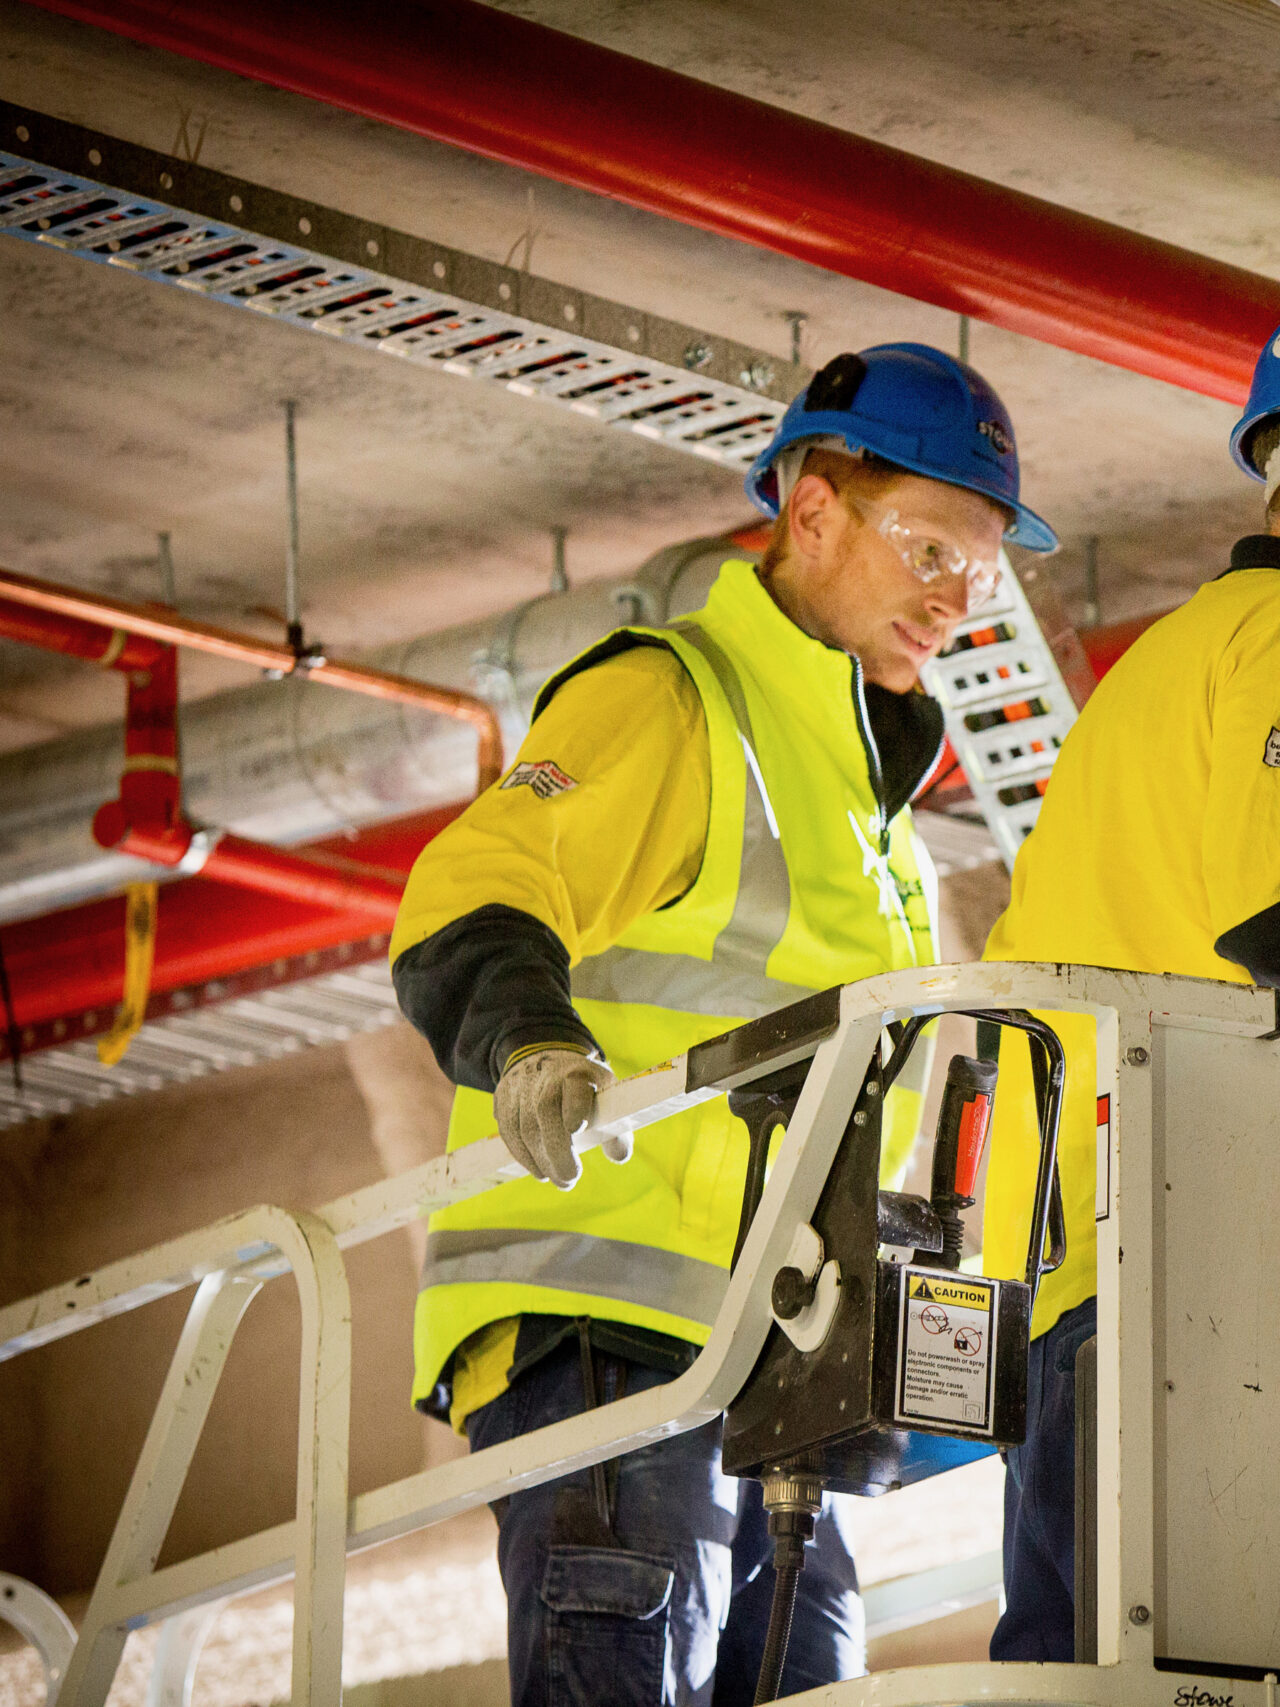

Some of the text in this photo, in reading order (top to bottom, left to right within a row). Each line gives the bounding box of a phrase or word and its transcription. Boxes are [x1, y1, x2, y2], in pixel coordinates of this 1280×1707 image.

[934, 1286, 986, 1303] CAUTION
[928, 1353, 961, 1363] powerwash
[908, 1358, 936, 1368] electronic
[937, 1363, 972, 1373] components
[907, 1367, 940, 1377] connectors.
[907, 1375, 931, 1384] Moisture
[906, 1384, 929, 1393] damage
[906, 1394, 934, 1402] operation.
